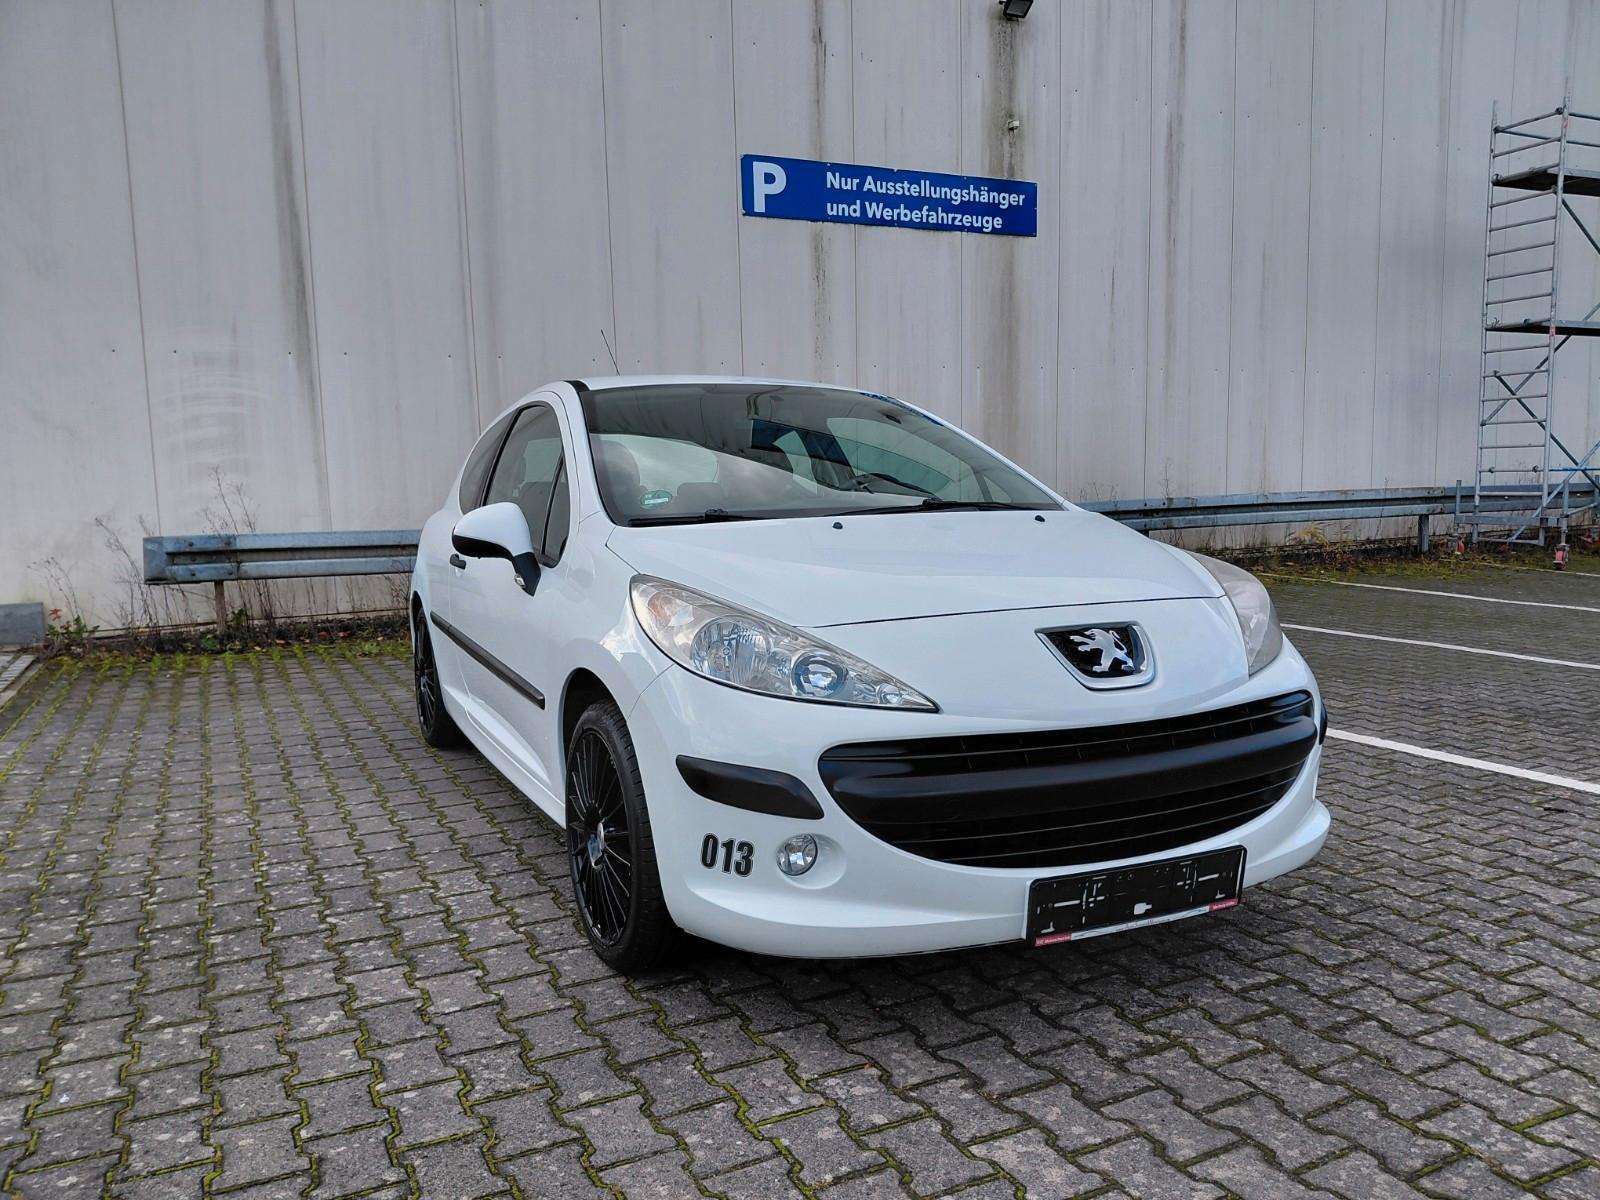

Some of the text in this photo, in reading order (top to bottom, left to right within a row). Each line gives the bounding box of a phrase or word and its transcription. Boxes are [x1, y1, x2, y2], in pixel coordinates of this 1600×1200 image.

[752, 161, 787, 213] P
[826, 172, 1025, 209] Nur Ausstellungshänger
[826, 199, 1003, 232] und Werbefahrzeuge
[701, 832, 755, 877] 013
